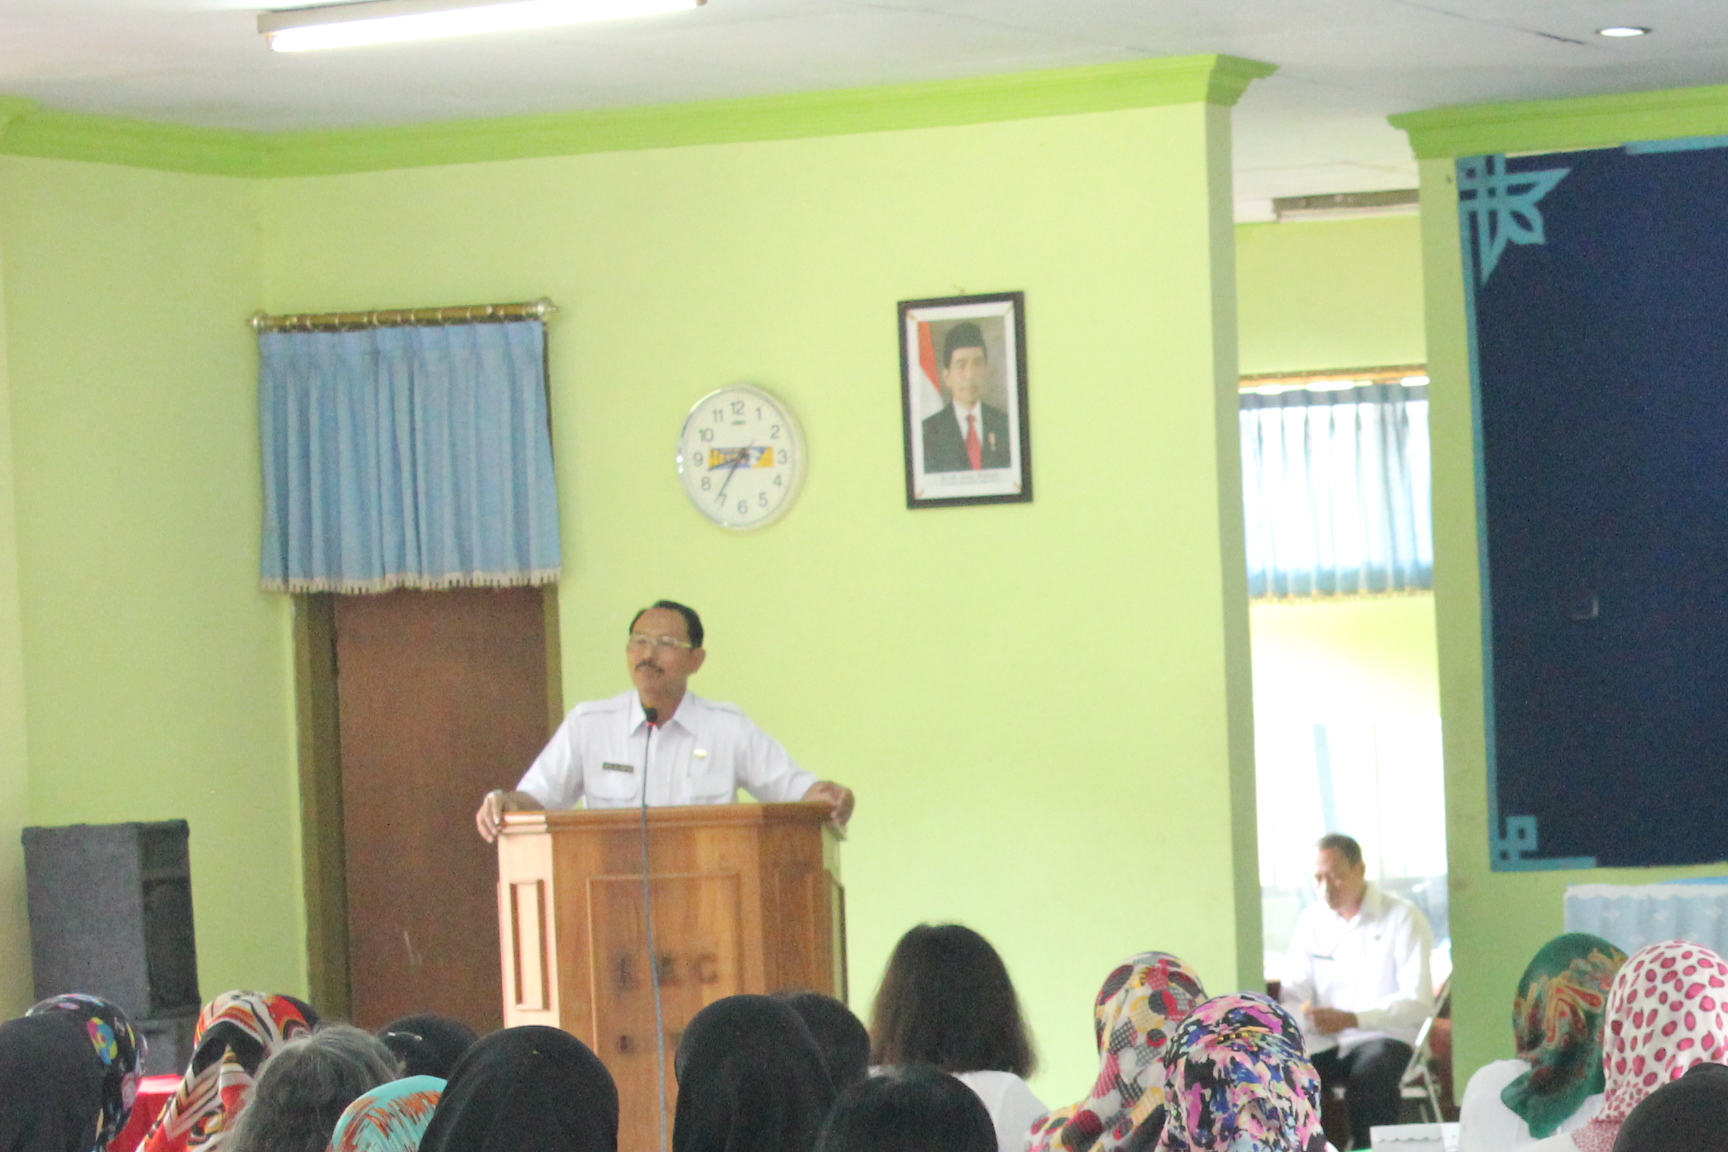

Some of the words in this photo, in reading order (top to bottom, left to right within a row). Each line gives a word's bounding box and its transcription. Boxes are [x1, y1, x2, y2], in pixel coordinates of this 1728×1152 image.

[712, 408, 724, 423] 11
[730, 400, 745, 416] 12
[755, 407, 762, 421] 1
[698, 427, 715, 443] 10
[770, 424, 781, 440] 2
[693, 451, 704, 467] 9
[777, 449, 788, 465] 3
[701, 476, 712, 491] 8
[773, 474, 783, 488] 4
[737, 499, 749, 515] 6
[758, 492, 769, 508] 5
